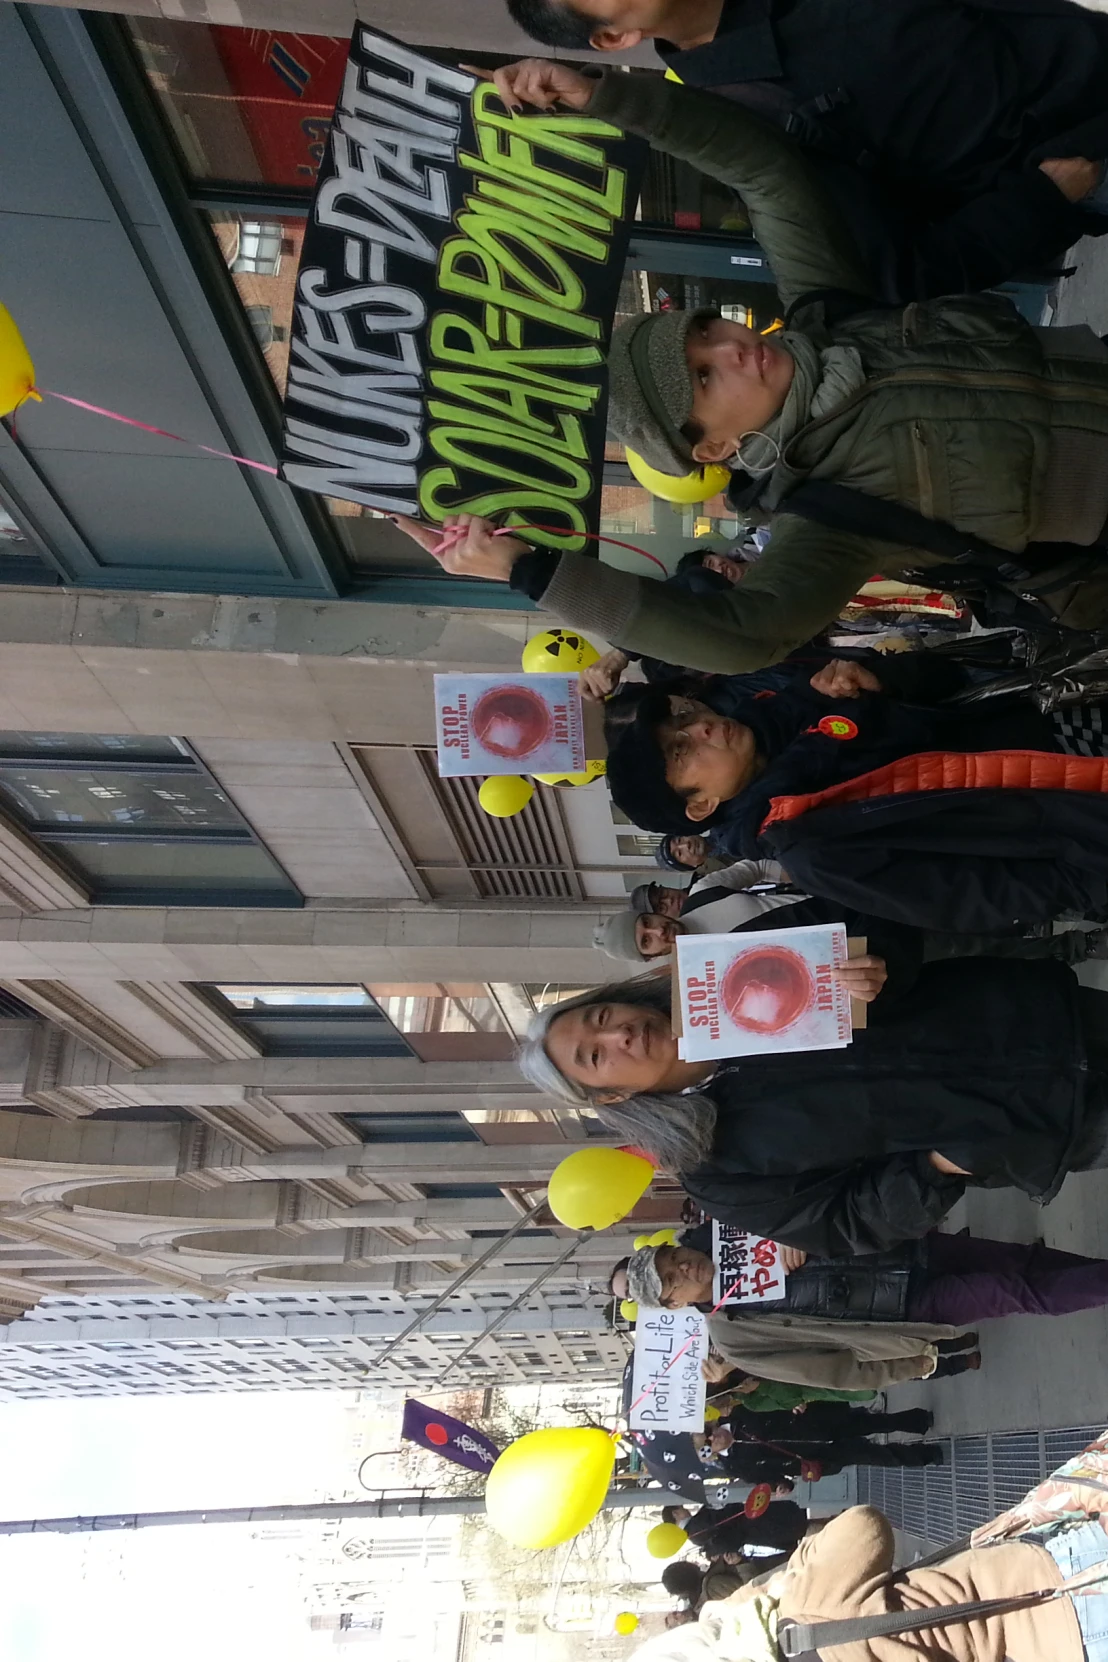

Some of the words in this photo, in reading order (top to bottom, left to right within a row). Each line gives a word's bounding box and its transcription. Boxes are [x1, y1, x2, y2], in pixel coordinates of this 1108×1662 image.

[283, 30, 477, 516] NUKES=DEATH
[442, 706, 460, 748] STOP
[458, 694, 468, 721] POWER
[553, 705, 568, 744] JAPAN
[460, 724, 470, 760] NUCLEAR
[705, 960, 716, 994] POWER
[816, 964, 833, 1011] JAPAN
[686, 976, 709, 1028] STOP
[708, 998, 720, 1040] NUCLEAR
[750, 1236, 779, 1297] やめ
[644, 1314, 674, 1354] Life
[684, 1316, 702, 1340] You?
[661, 1354, 671, 1370] or
[684, 1340, 700, 1359] Are
[682, 1361, 699, 1380] Side
[640, 1370, 671, 1422] Profit
[678, 1384, 698, 1418] Which
